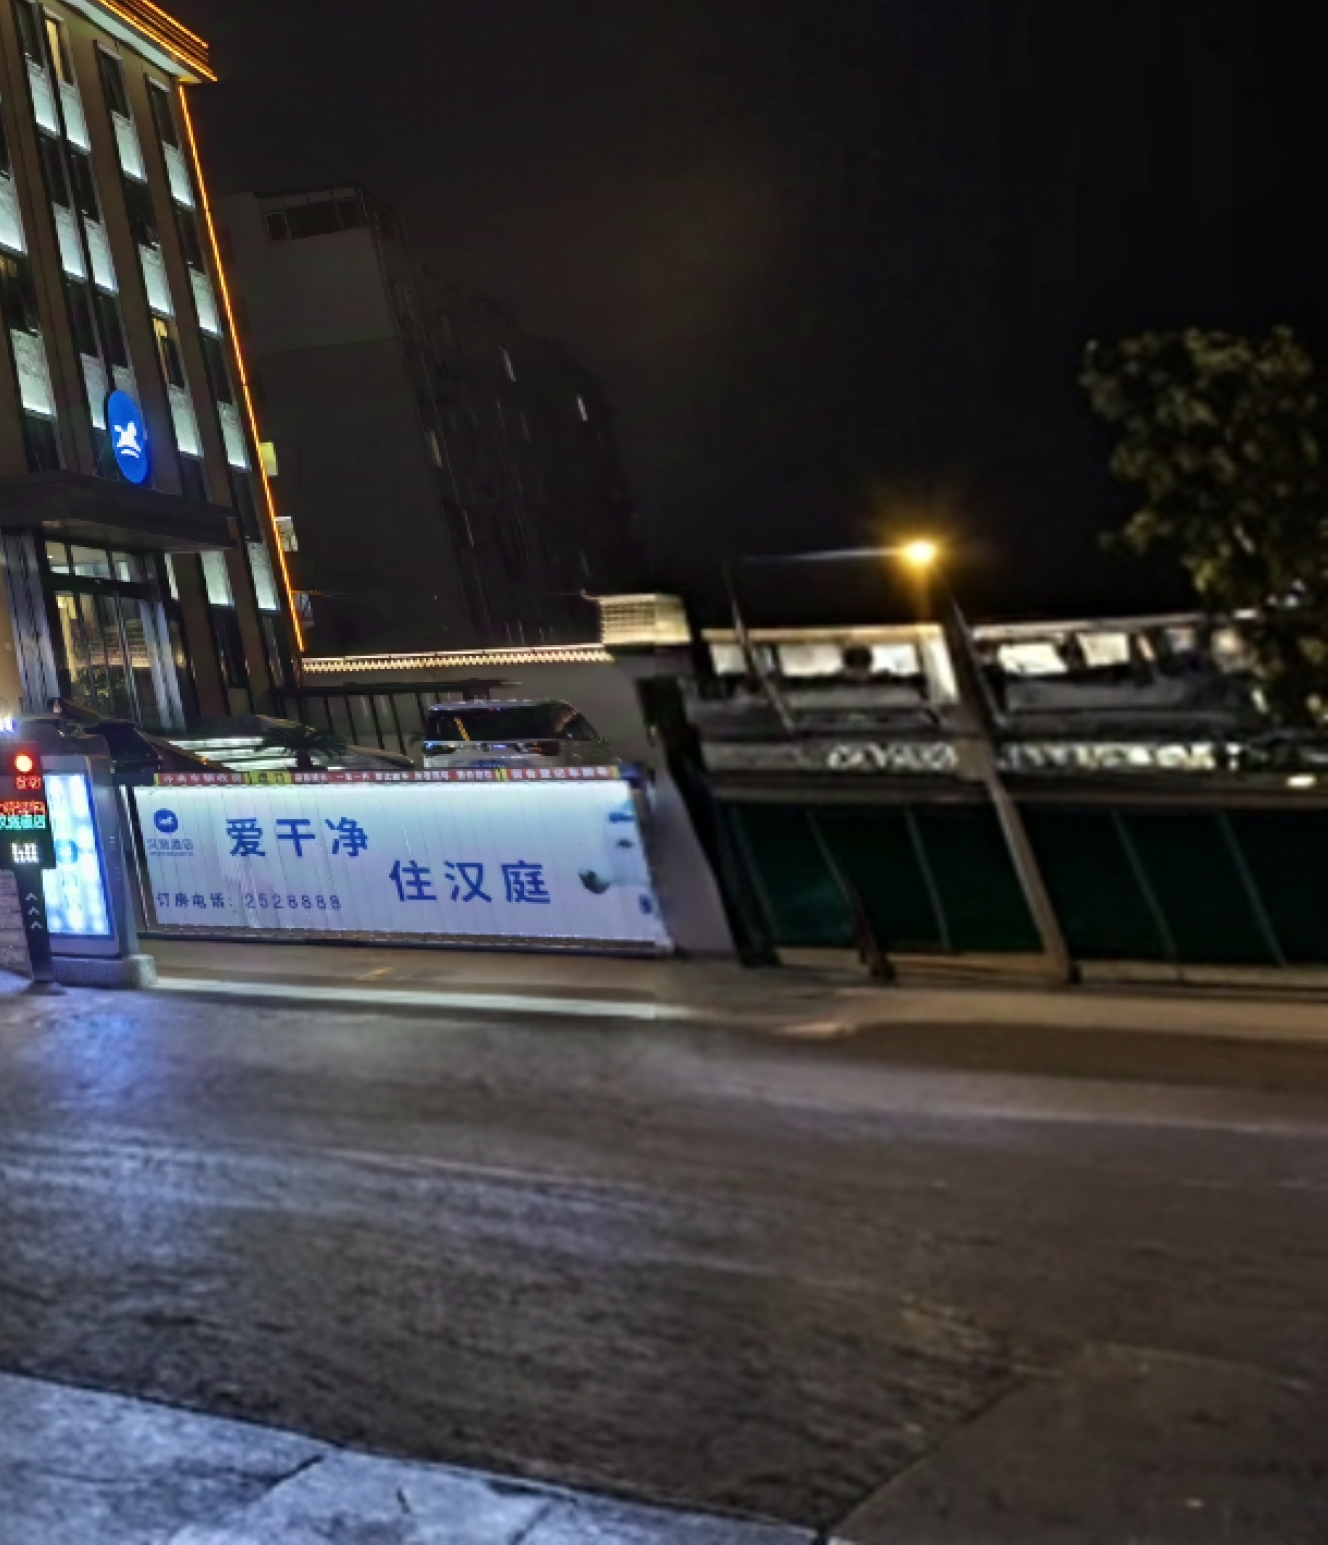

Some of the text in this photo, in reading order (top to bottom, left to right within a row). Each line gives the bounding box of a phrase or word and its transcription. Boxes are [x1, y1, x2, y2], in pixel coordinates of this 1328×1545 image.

[226, 817, 369, 857] 爱干净
[390, 860, 550, 903] 住汉庭
